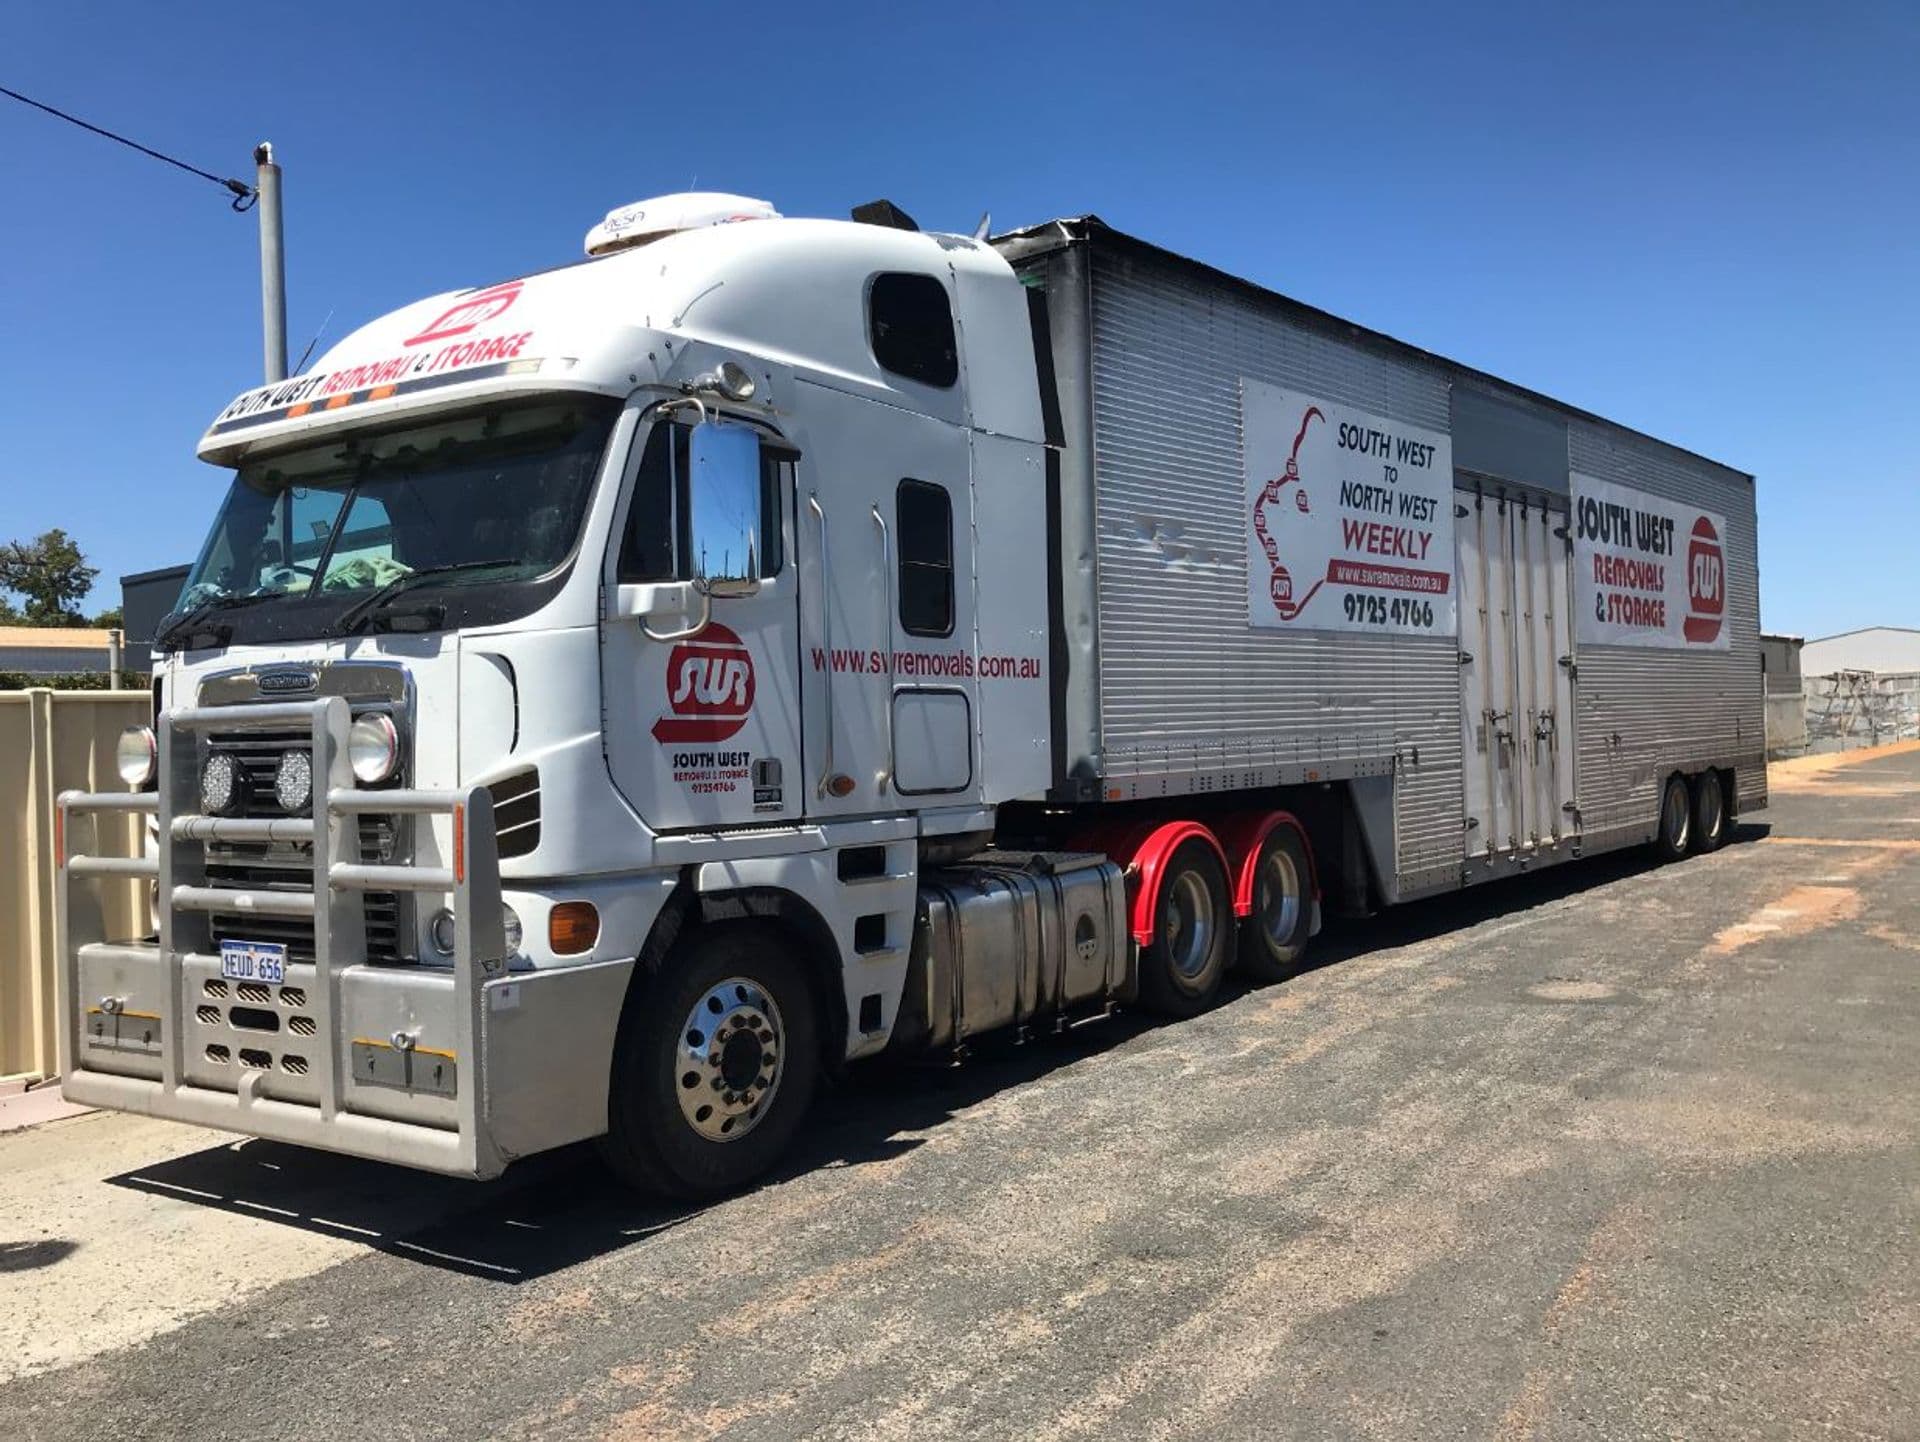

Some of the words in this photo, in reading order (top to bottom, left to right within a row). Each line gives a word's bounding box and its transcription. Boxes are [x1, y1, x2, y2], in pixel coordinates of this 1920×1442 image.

[271, 373, 327, 407] WEST
[319, 353, 419, 395] REMOVALS
[427, 331, 533, 372] STORAGE
[1337, 422, 1391, 459] SOUTH
[1397, 437, 1436, 470] WEST
[1383, 464, 1398, 484] TO
[1340, 480, 1392, 515] NORTH
[1399, 492, 1438, 523] WEST
[1342, 518, 1433, 561] WEEKLY
[1577, 495, 1632, 548] SOUTH
[1636, 510, 1674, 556] WEST
[1594, 553, 1664, 592] REMOVALS
[1343, 593, 1387, 625] 9725
[1390, 600, 1434, 628] 4766
[1596, 592, 1605, 622] &
[1608, 593, 1665, 628] STORAGE
[673, 752, 715, 768] SOUTH
[718, 751, 750, 767] WEST
